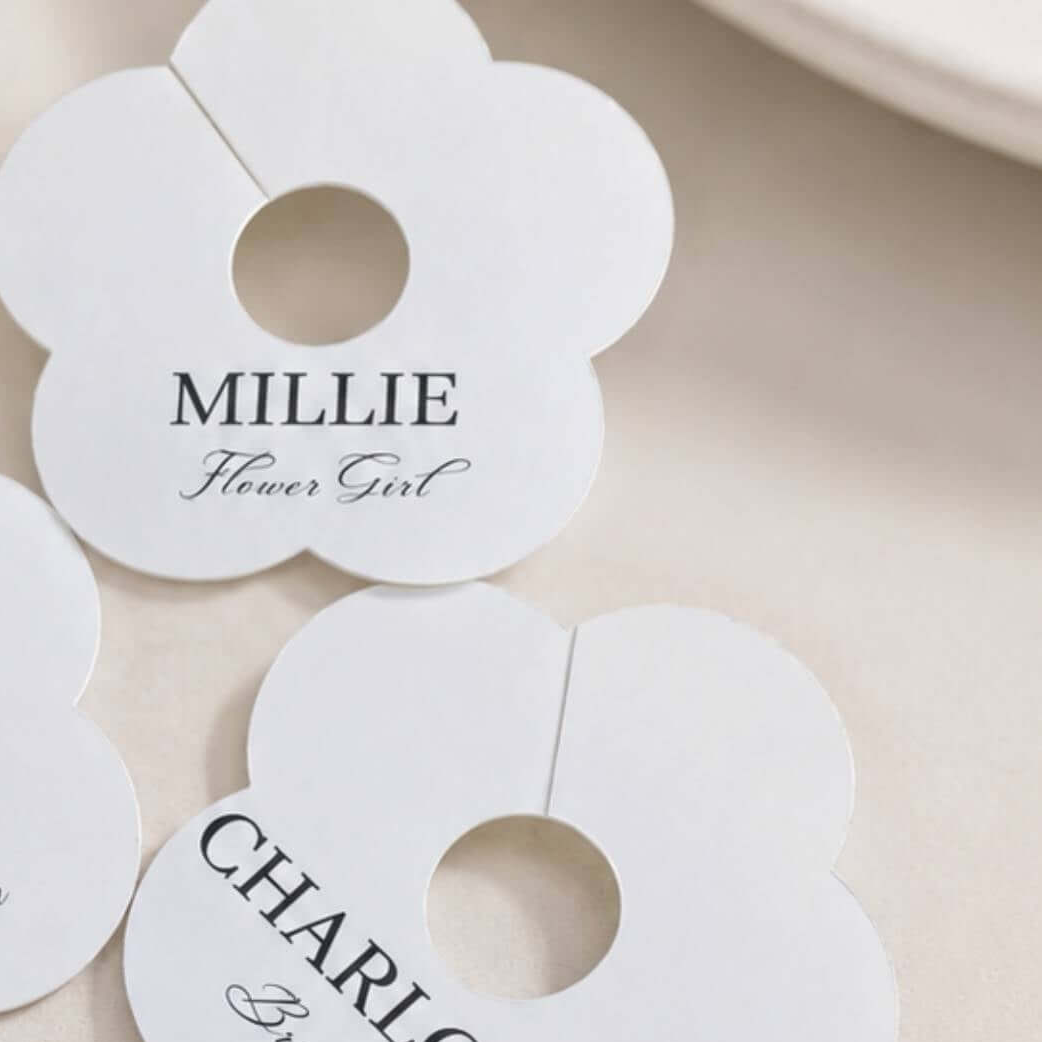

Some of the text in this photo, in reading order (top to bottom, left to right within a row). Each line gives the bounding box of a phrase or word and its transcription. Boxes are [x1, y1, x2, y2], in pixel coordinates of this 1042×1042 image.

[170, 372, 459, 427] MILLIE
[179, 449, 472, 503] Flower Girl
